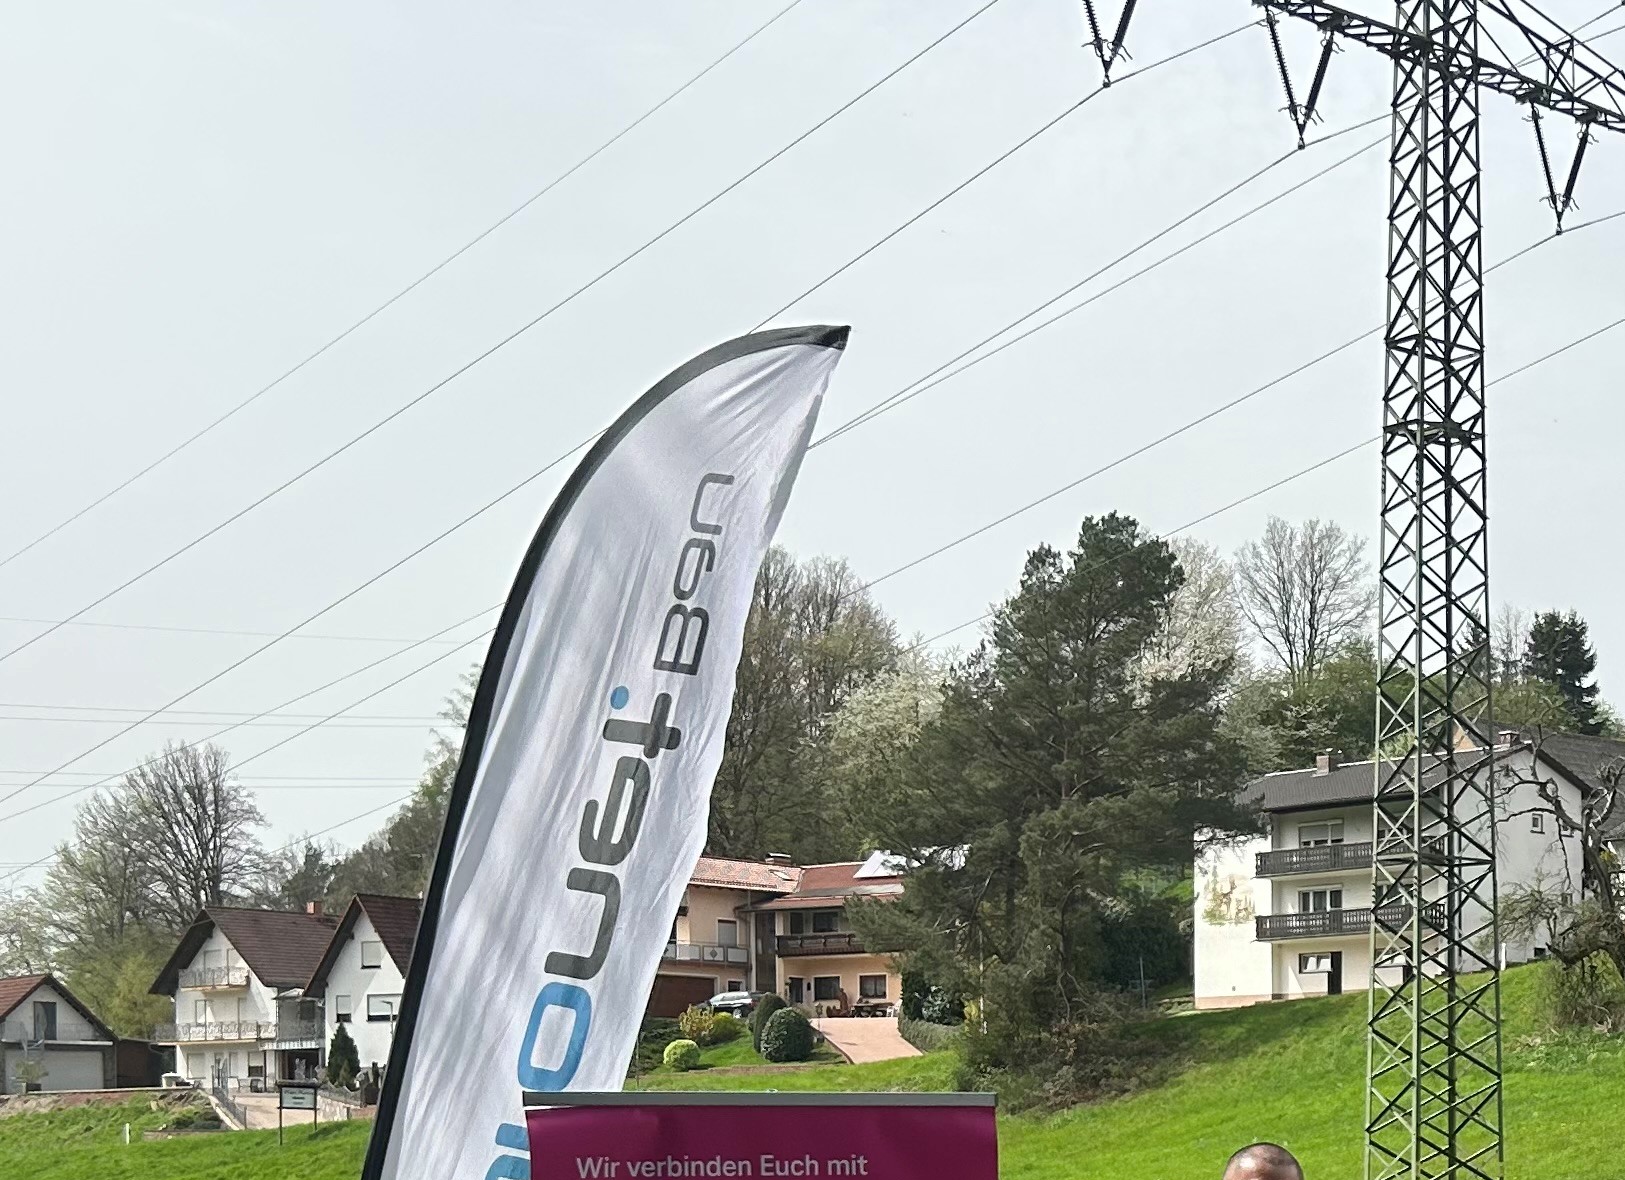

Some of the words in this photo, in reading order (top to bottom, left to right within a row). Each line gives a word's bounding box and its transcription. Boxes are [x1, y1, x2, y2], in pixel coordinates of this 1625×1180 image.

[576, 1156, 621, 1179] Wir
[626, 1155, 752, 1178] verbinden
[760, 1154, 819, 1177] Euch
[827, 1154, 869, 1176] mit
